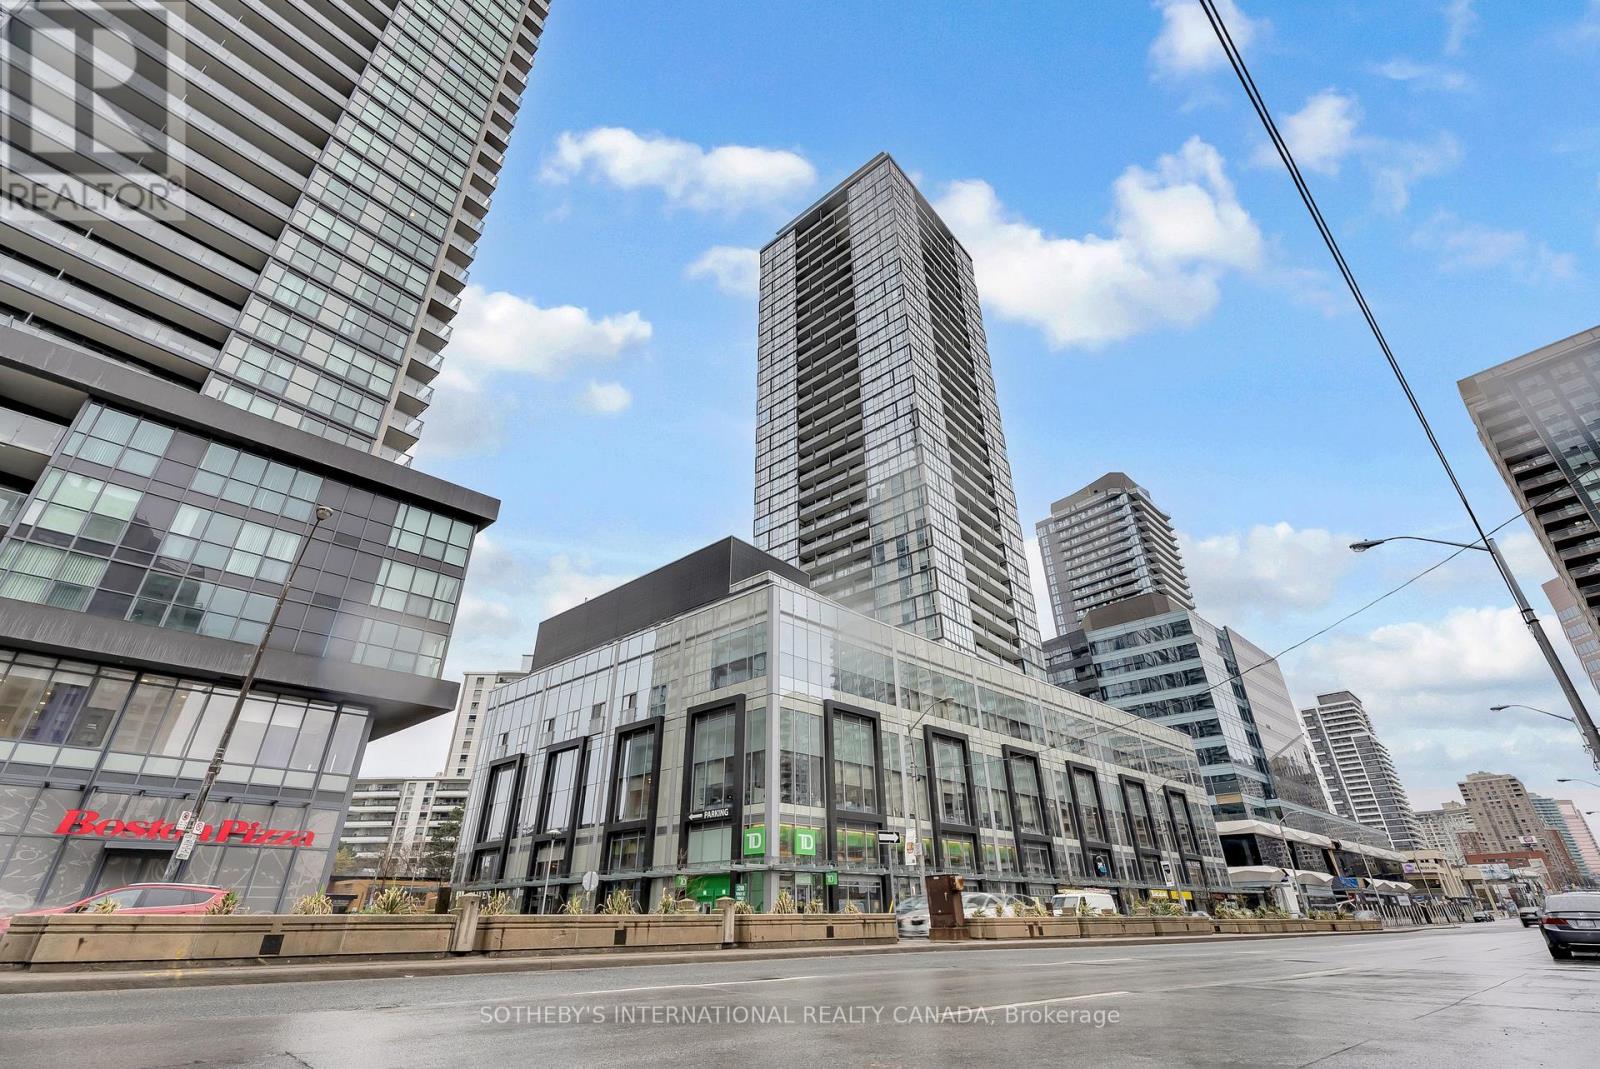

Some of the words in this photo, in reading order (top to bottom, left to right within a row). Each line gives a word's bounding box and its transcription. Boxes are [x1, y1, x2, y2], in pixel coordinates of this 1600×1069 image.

[703, 808, 729, 819] PARKING
[215, 819, 315, 848] Pizza
[746, 832, 762, 849] TD
[798, 833, 814, 850] TD
